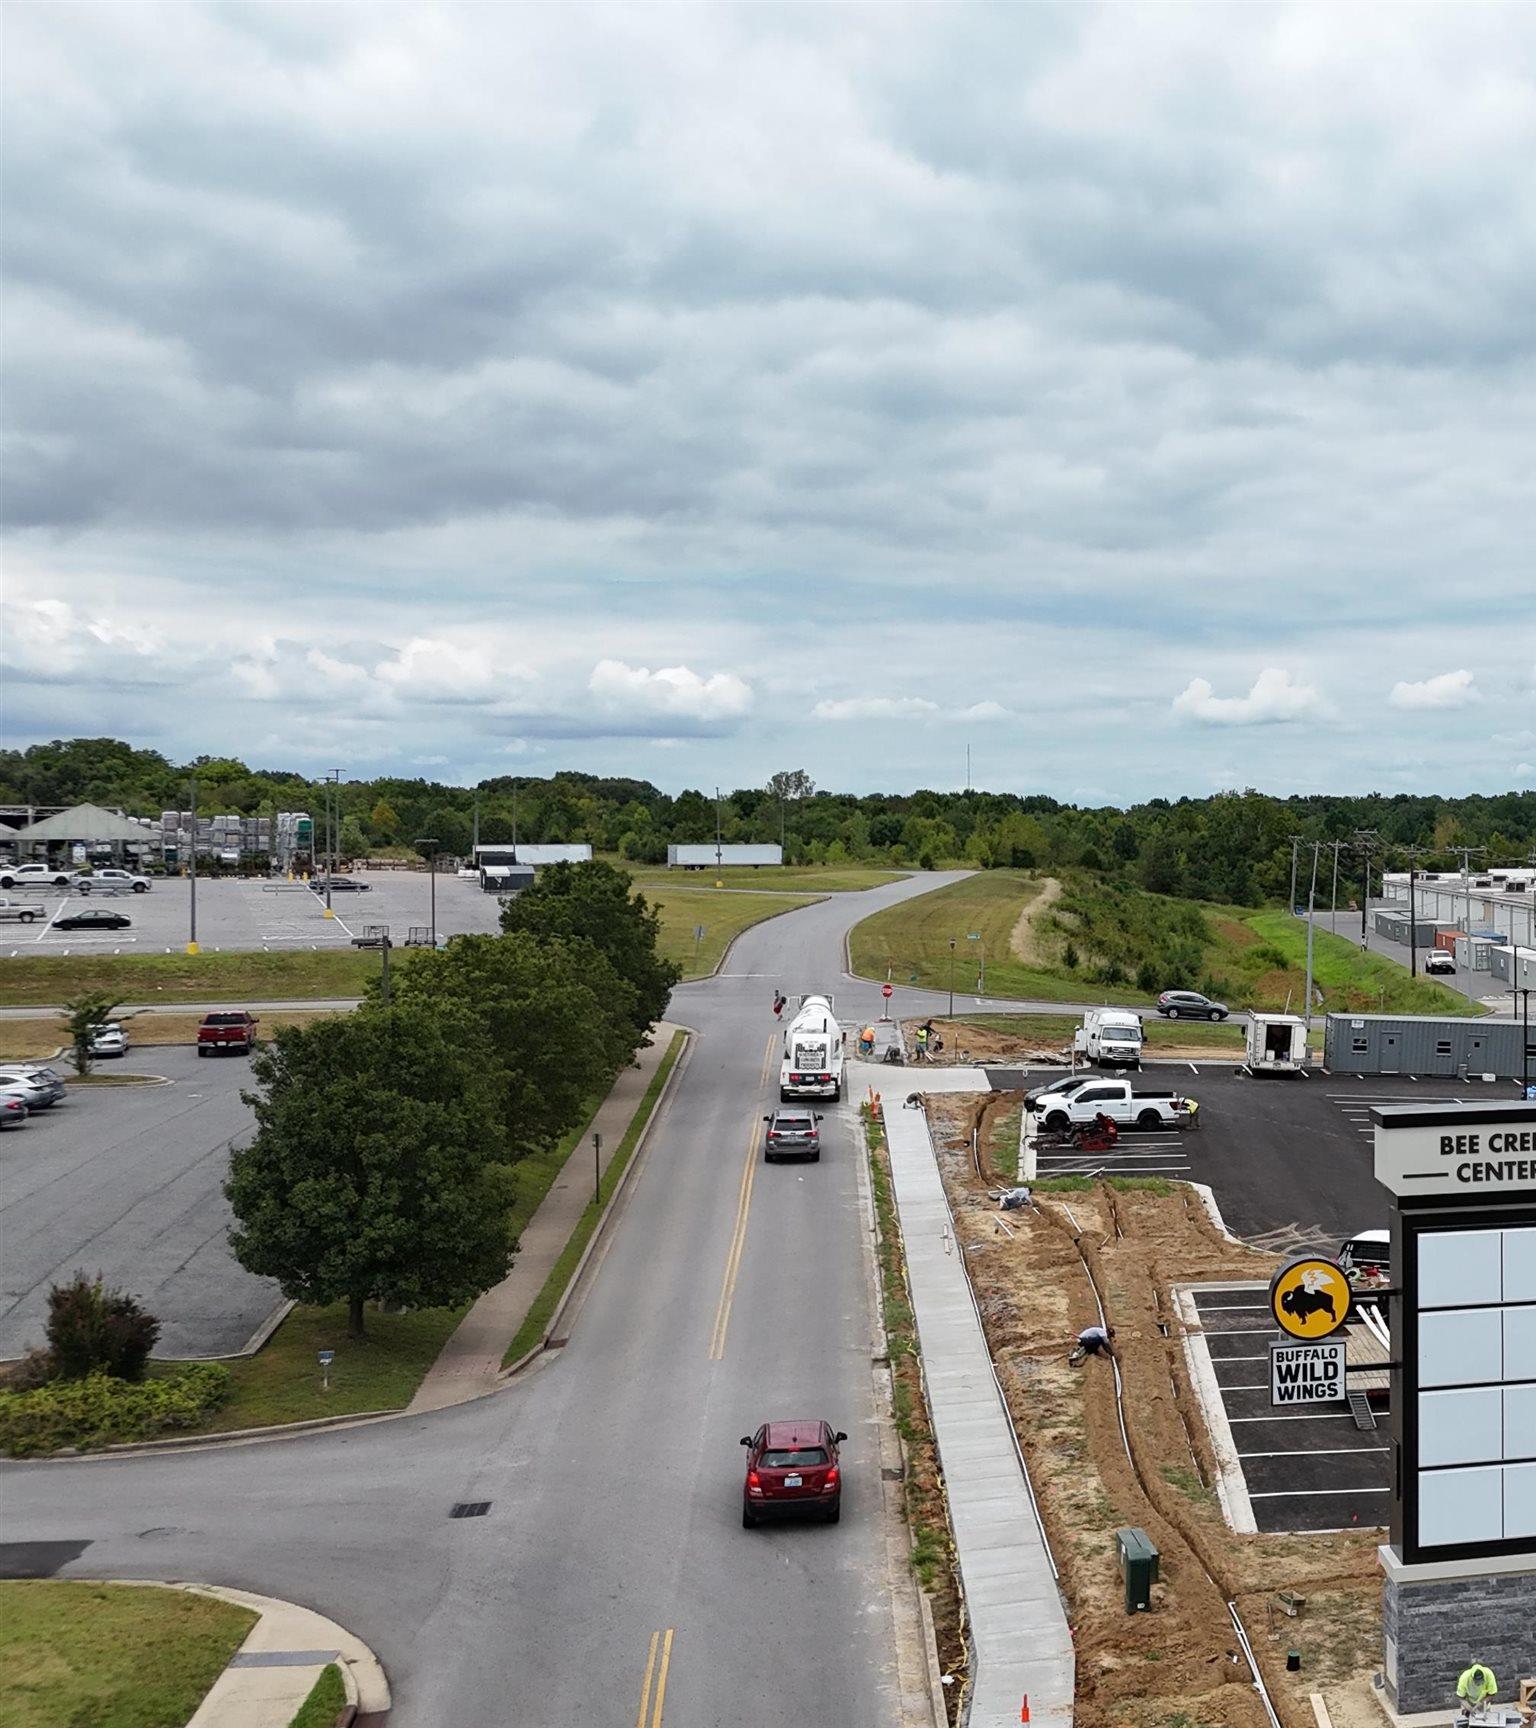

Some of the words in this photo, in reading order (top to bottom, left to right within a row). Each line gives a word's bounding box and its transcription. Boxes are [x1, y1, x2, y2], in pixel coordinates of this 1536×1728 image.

[1440, 1135, 1480, 1155] BEE
[1276, 1347, 1338, 1363] BUFFALO
[1276, 1361, 1339, 1384] WILD
[1277, 1382, 1339, 1402] WINGS
